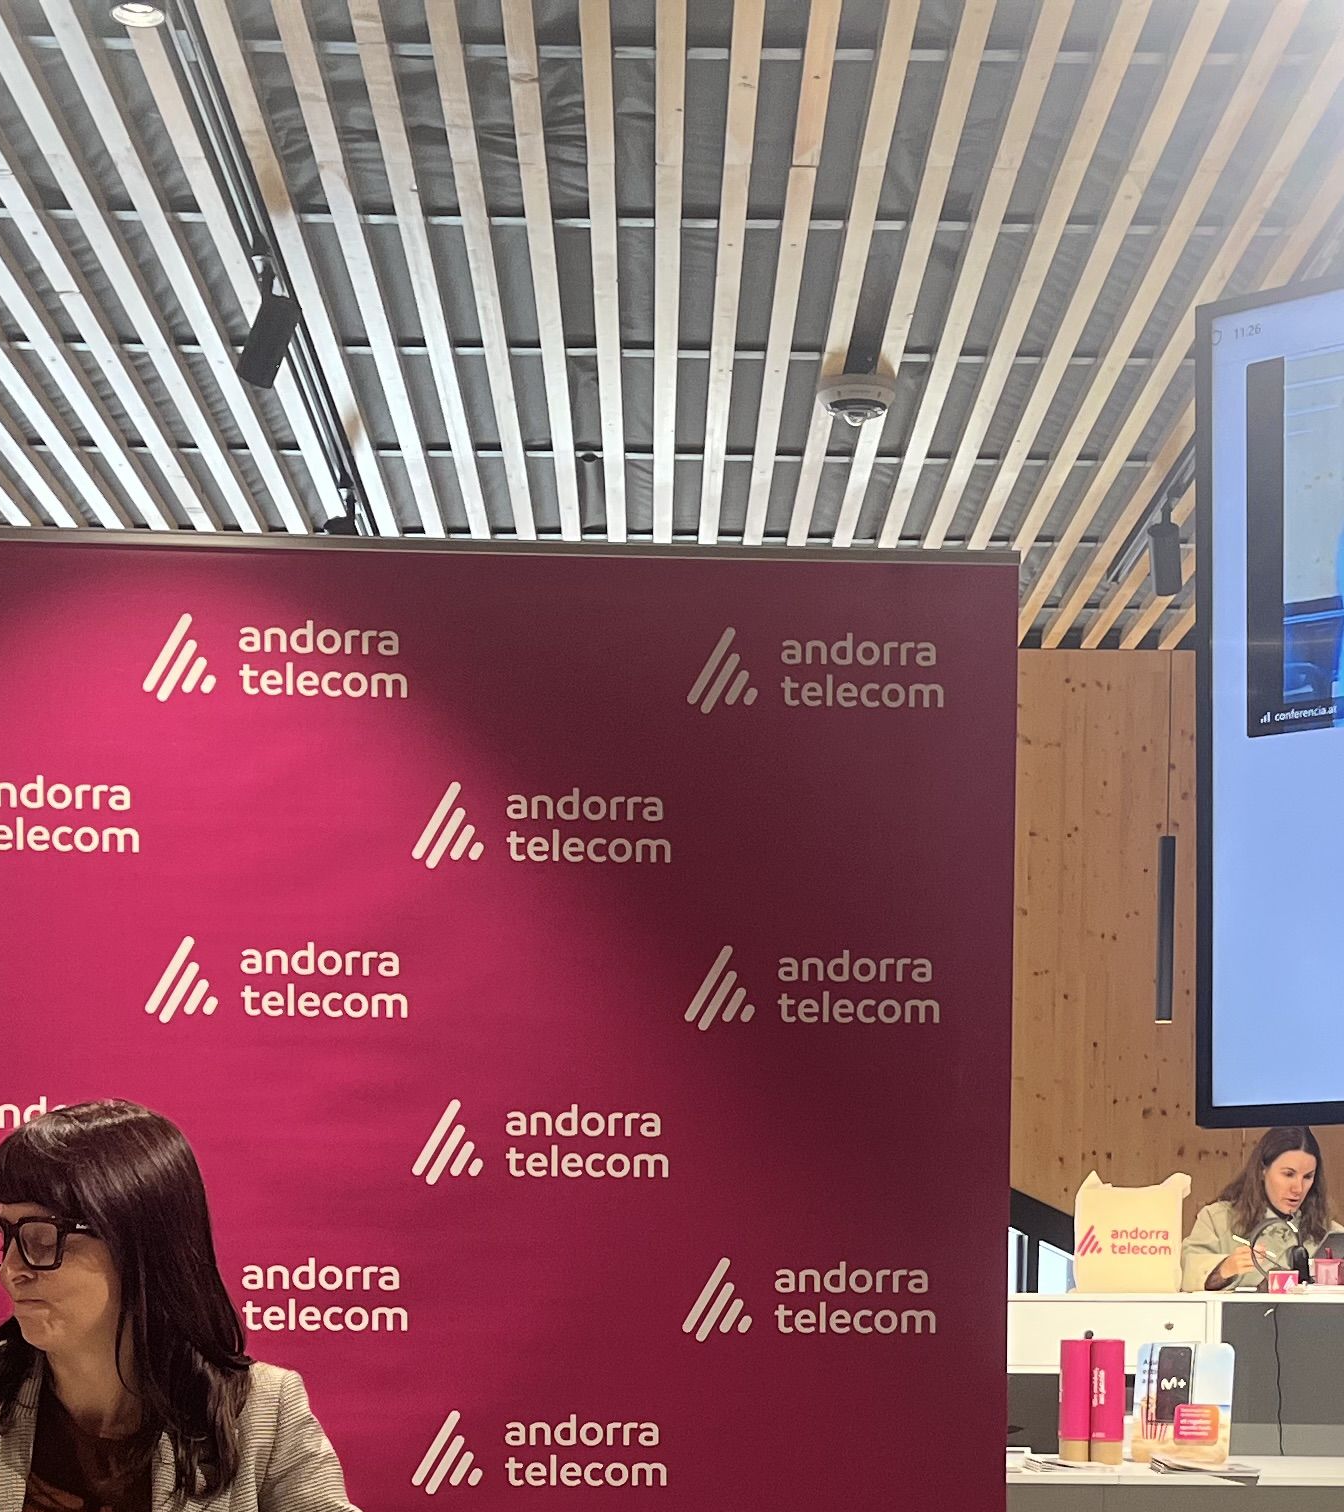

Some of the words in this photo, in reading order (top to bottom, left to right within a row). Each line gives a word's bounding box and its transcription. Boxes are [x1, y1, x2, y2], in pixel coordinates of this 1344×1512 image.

[239, 620, 398, 655] andorra
[781, 633, 936, 666] andorra
[239, 662, 407, 698] telecom
[781, 674, 944, 707] telecom
[507, 788, 663, 821] andorra
[506, 829, 670, 863] telecom
[240, 942, 399, 976] andorra
[778, 950, 932, 982] andorra
[241, 983, 407, 1018] telecom
[777, 991, 939, 1023] telecom
[506, 1104, 661, 1137] andorra
[506, 1145, 668, 1178] telecom
[1111, 1227, 1169, 1240] andorra
[1111, 1242, 1171, 1255] telecom
[242, 1258, 399, 1290] andorra
[775, 1261, 928, 1293] andorra
[242, 1299, 407, 1331] telecom
[774, 1302, 935, 1333] telecom
[505, 1414, 659, 1446] andorra
[505, 1455, 667, 1486] telecom
